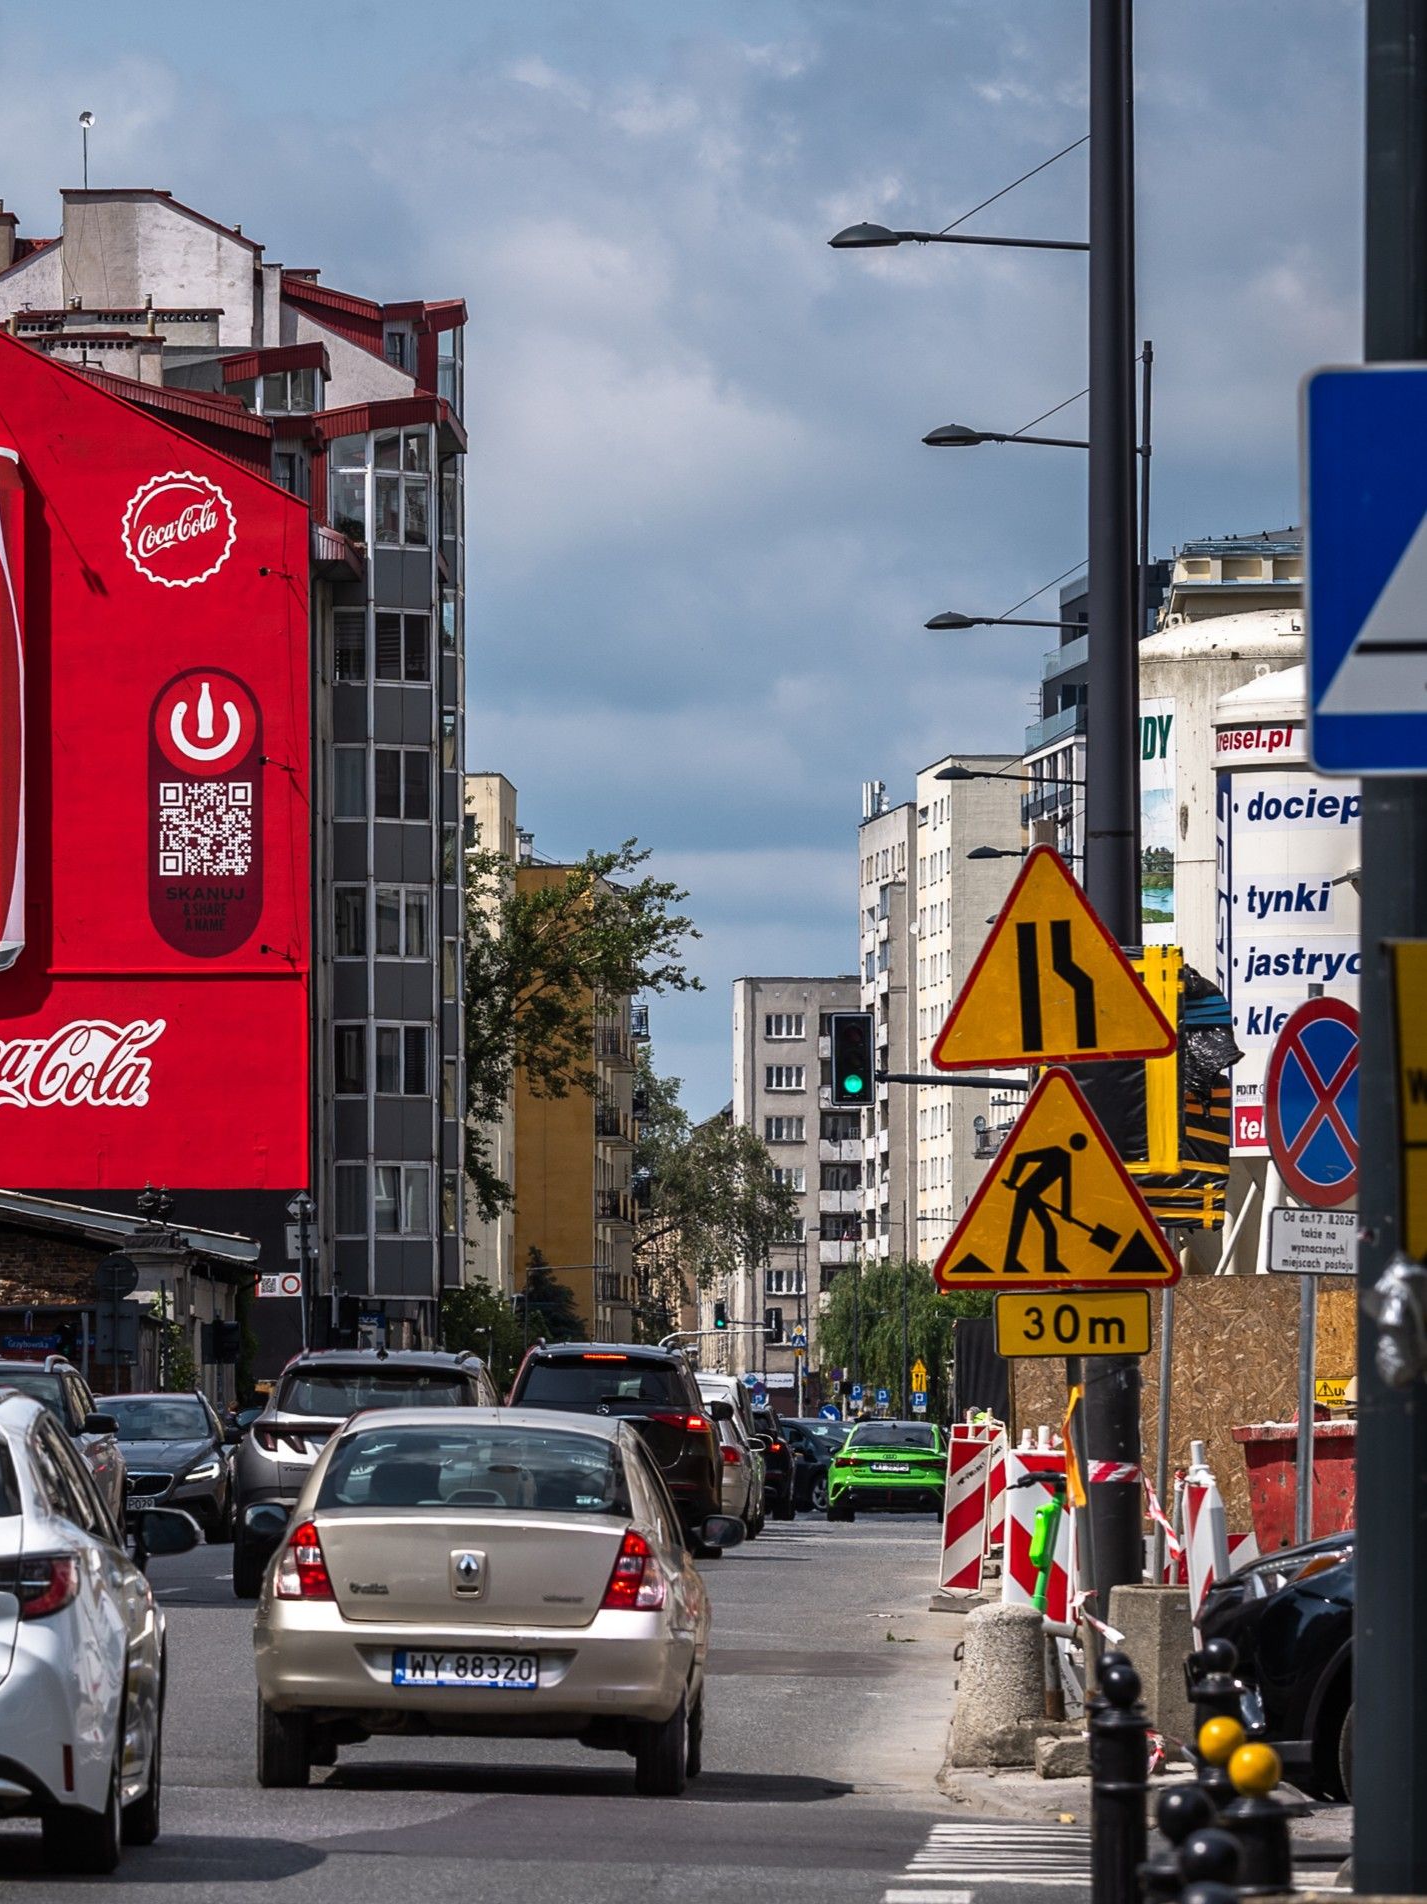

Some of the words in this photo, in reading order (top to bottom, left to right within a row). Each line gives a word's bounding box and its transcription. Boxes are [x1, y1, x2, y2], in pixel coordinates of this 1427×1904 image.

[136, 495, 219, 558] Coca-Cola
[166, 886, 245, 900] SKANUJ
[1247, 881, 1331, 920] tynki
[193, 902, 228, 916] SHARE
[194, 918, 226, 932] NAME
[1236, 1084, 1258, 1095] FIXIT
[1283, 1211, 1295, 1222] Od
[1301, 1228, 1322, 1240] także
[1326, 1231, 1336, 1240] na
[1291, 1243, 1345, 1257] wyznaczonych
[1282, 1256, 1321, 1269] miejscach
[1324, 1258, 1354, 1273] postoju
[410, 1654, 444, 1679] WY
[454, 1655, 533, 1681] 88320
